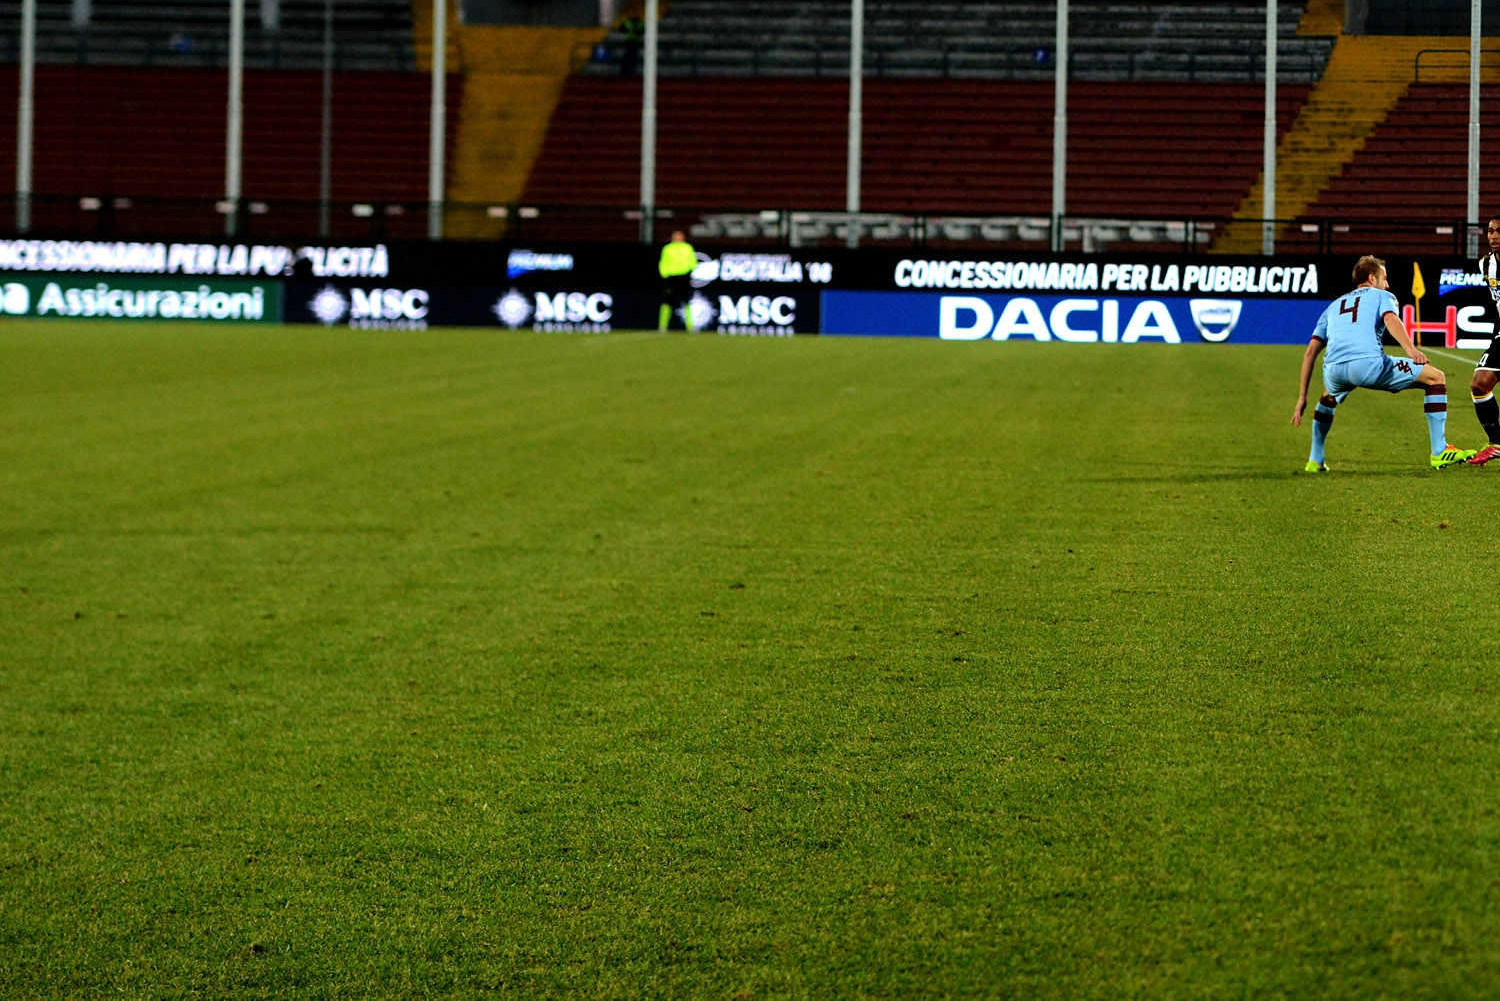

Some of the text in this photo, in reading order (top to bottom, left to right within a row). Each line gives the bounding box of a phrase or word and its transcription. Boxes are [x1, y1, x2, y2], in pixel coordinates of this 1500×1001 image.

[168, 243, 217, 274] PER
[216, 244, 249, 276] LA
[250, 243, 389, 277] PULICITÀ
[894, 260, 1319, 294] CONCESSIONARIA PER LA PUBBLICITÀ
[1440, 273, 1488, 286] PREMIU
[37, 282, 264, 319] Assicurazioni
[351, 288, 429, 320] MSC
[534, 291, 613, 323] MSC
[718, 294, 797, 326] MSC
[1339, 296, 1361, 323] 4
[939, 296, 1183, 344] DACIA
